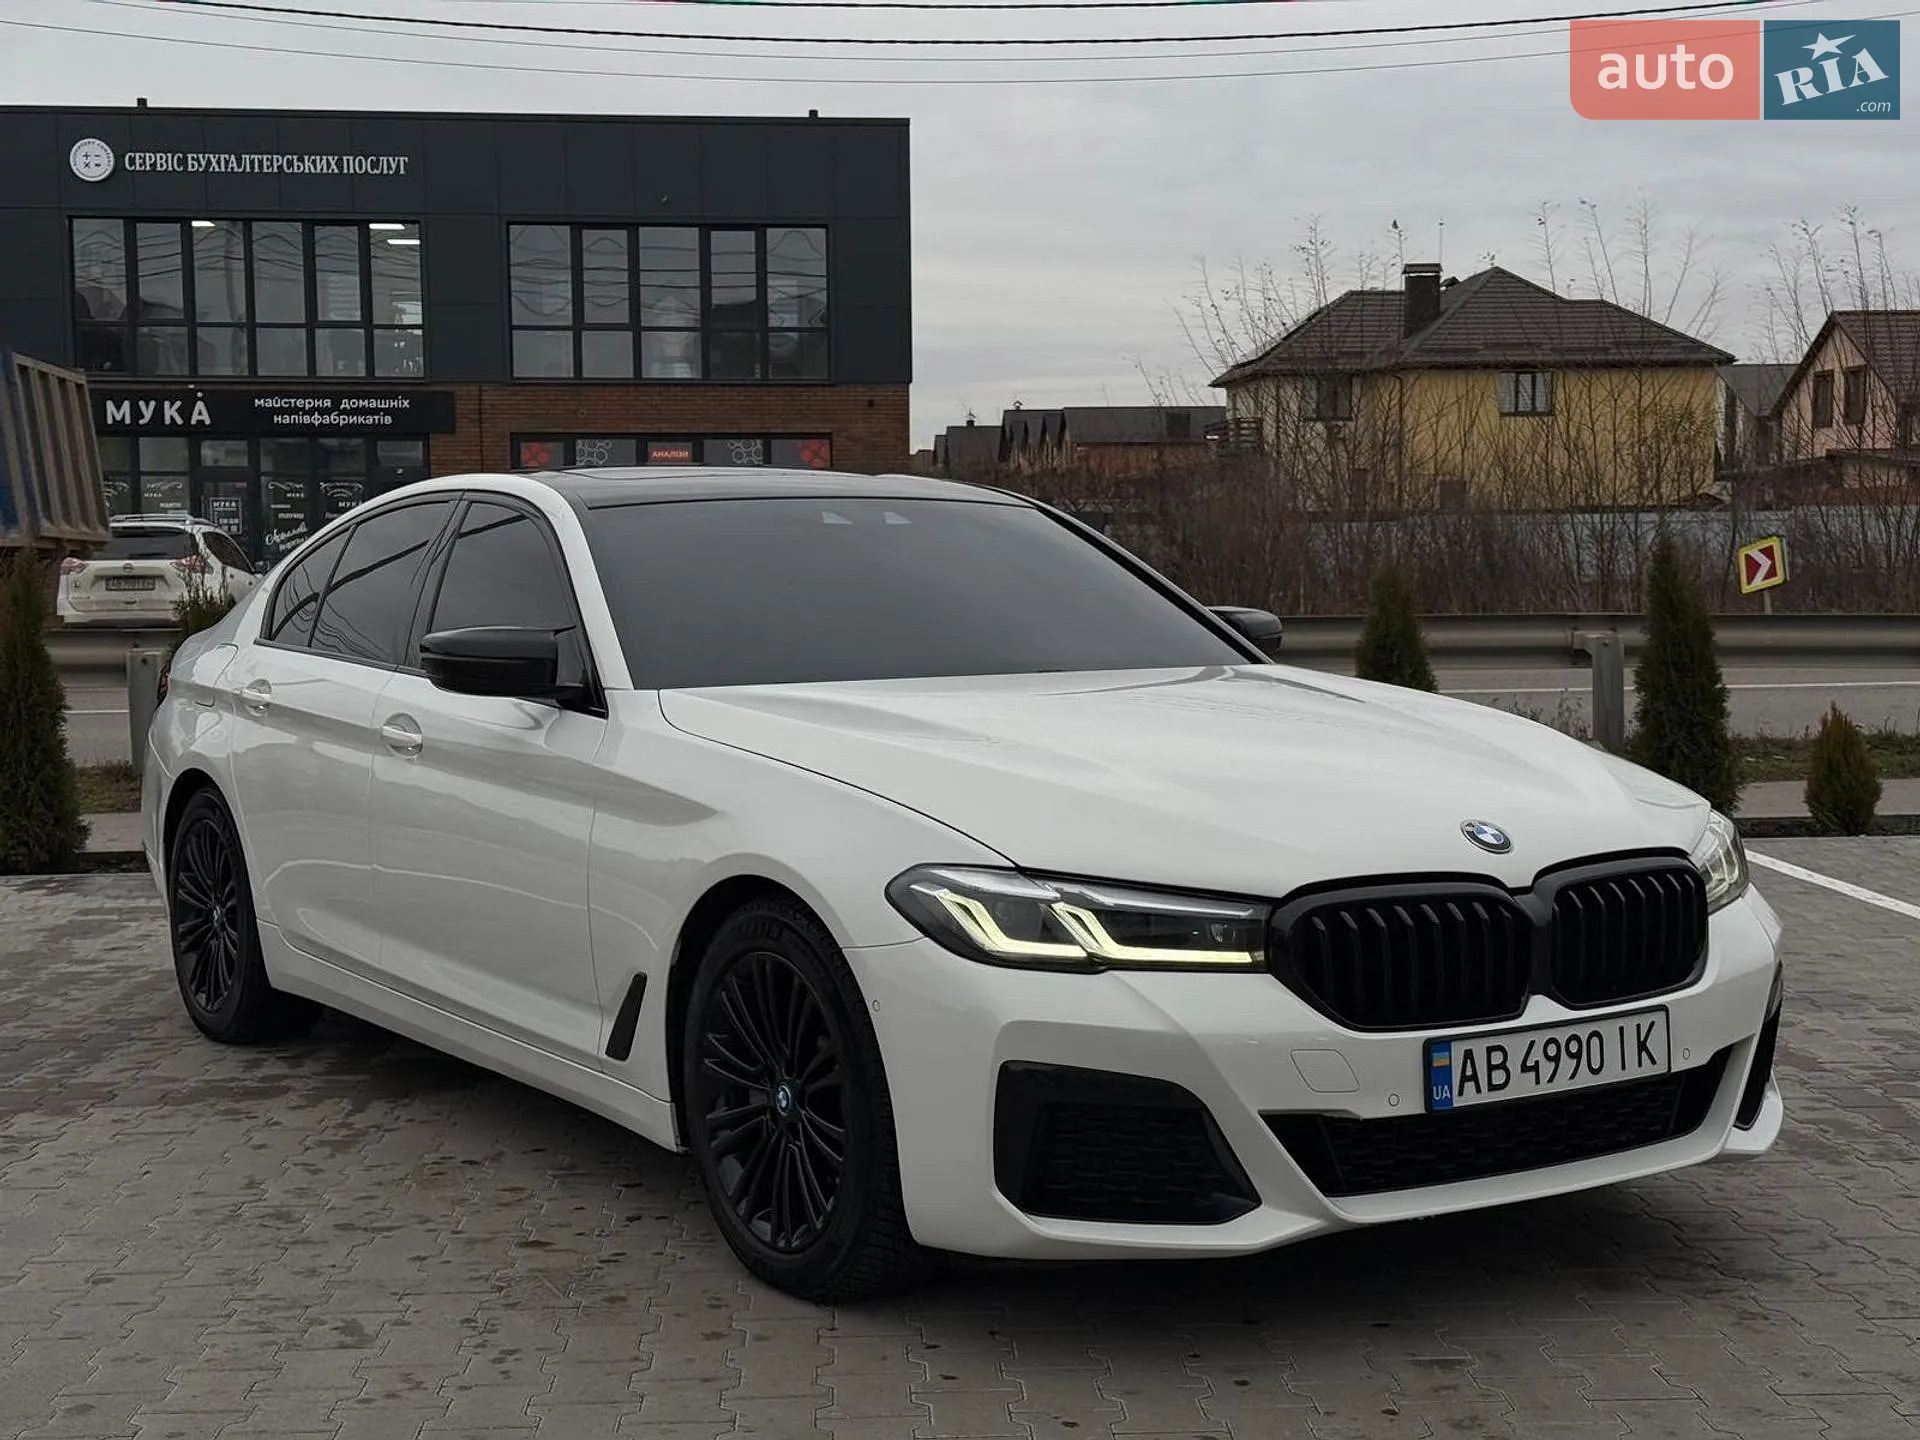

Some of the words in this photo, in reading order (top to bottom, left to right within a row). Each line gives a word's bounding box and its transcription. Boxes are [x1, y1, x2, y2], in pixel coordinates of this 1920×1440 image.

[124, 152, 184, 171] СЕРВІС
[186, 153, 340, 174] БУХГАЛТЕРСЬКИХ
[342, 155, 409, 175] ПОСЛУГ
[254, 397, 332, 410] майстерня
[339, 396, 410, 410] домашніх
[273, 411, 393, 427] напівфабрикатів
[1457, 1044, 1511, 1097] AB
[1520, 1030, 1605, 1085] 4990
[1618, 1020, 1658, 1068] IK
[1433, 1085, 1451, 1100] UA
